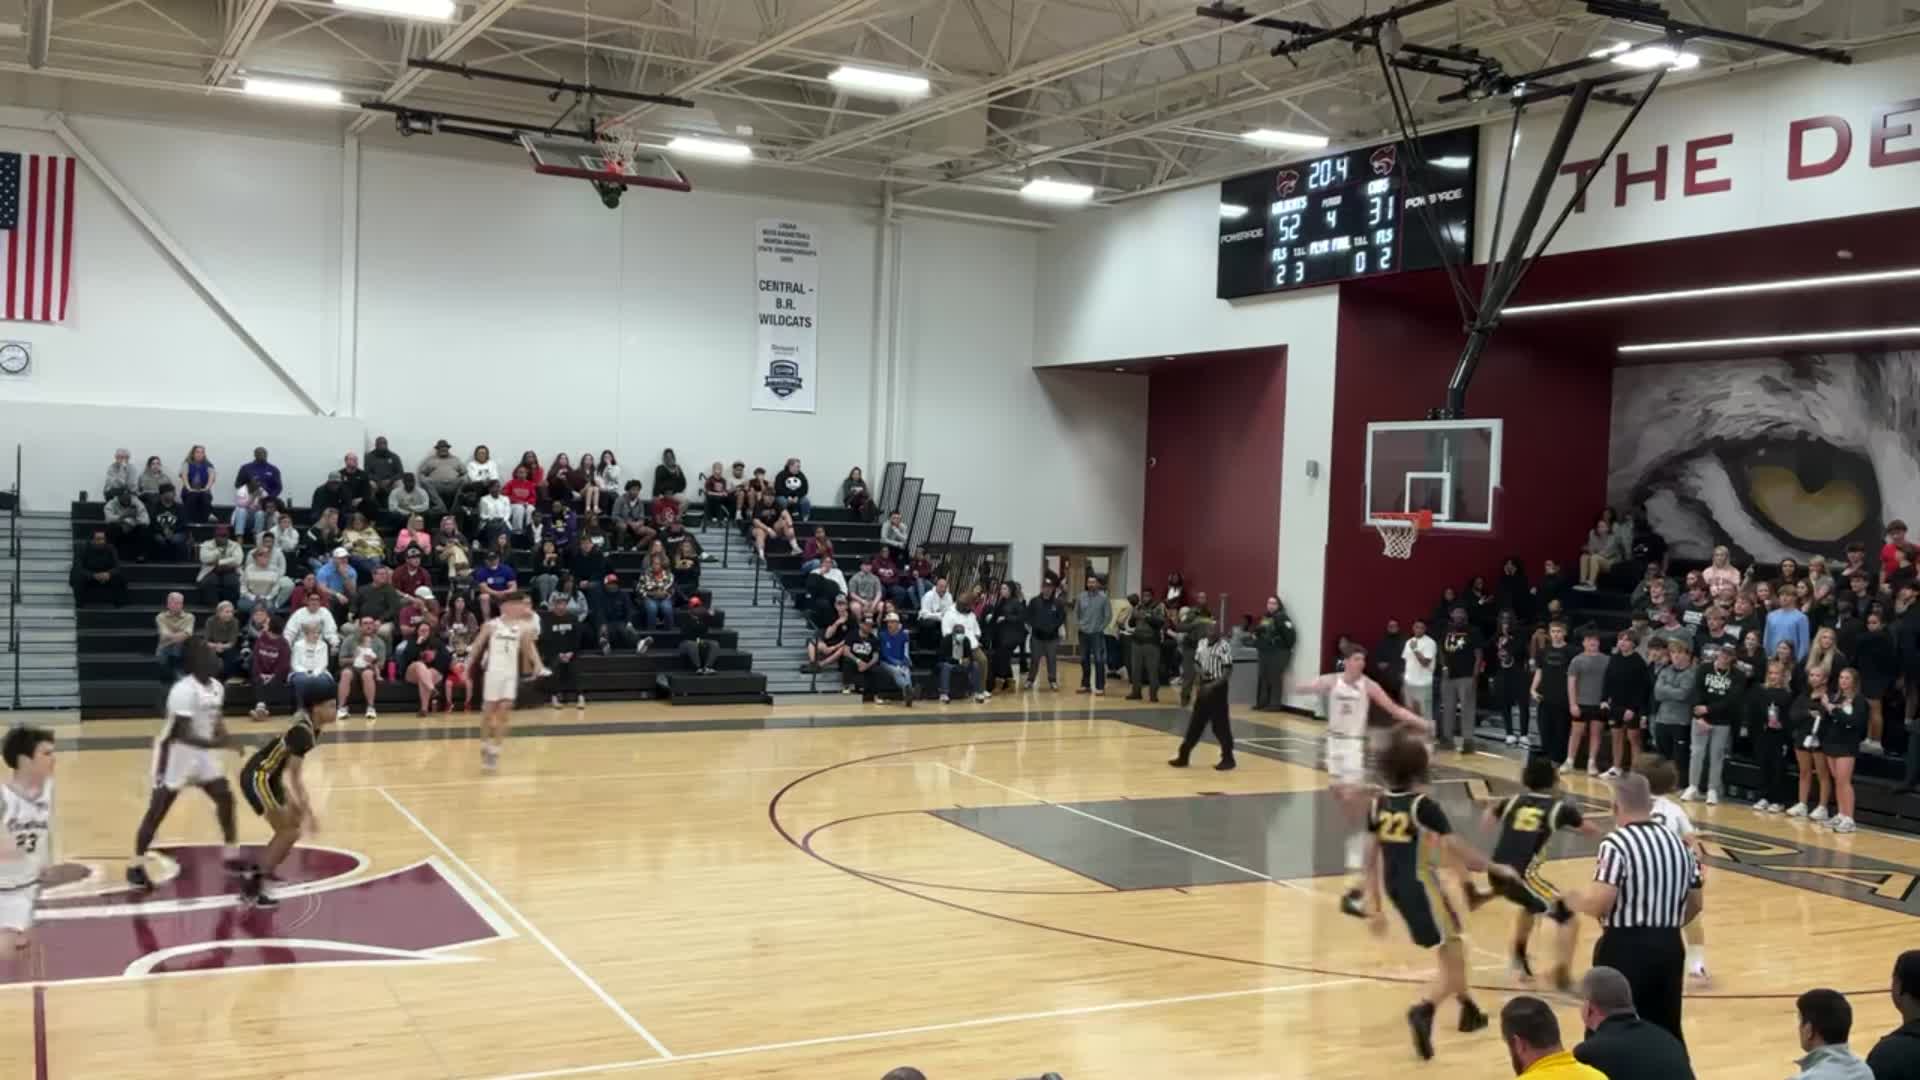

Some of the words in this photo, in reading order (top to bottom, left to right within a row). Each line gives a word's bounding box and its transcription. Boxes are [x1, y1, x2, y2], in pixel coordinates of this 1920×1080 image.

[1560, 133, 1734, 213] THE
[1787, 97, 1920, 181] DE
[1309, 156, 1350, 189] 20.4
[1326, 210, 1337, 228] 4
[1369, 195, 1395, 225] 31
[1279, 214, 1300, 241] 52
[1355, 252, 1366, 272] 0
[1379, 247, 1391, 269] 2
[1276, 264, 1286, 284] 2
[1296, 261, 1305, 282] 3
[759, 279, 806, 295] CENTRAL
[775, 297, 797, 310] B.R.
[759, 313, 812, 328] WILDCATS
[1377, 810, 1412, 843] 22
